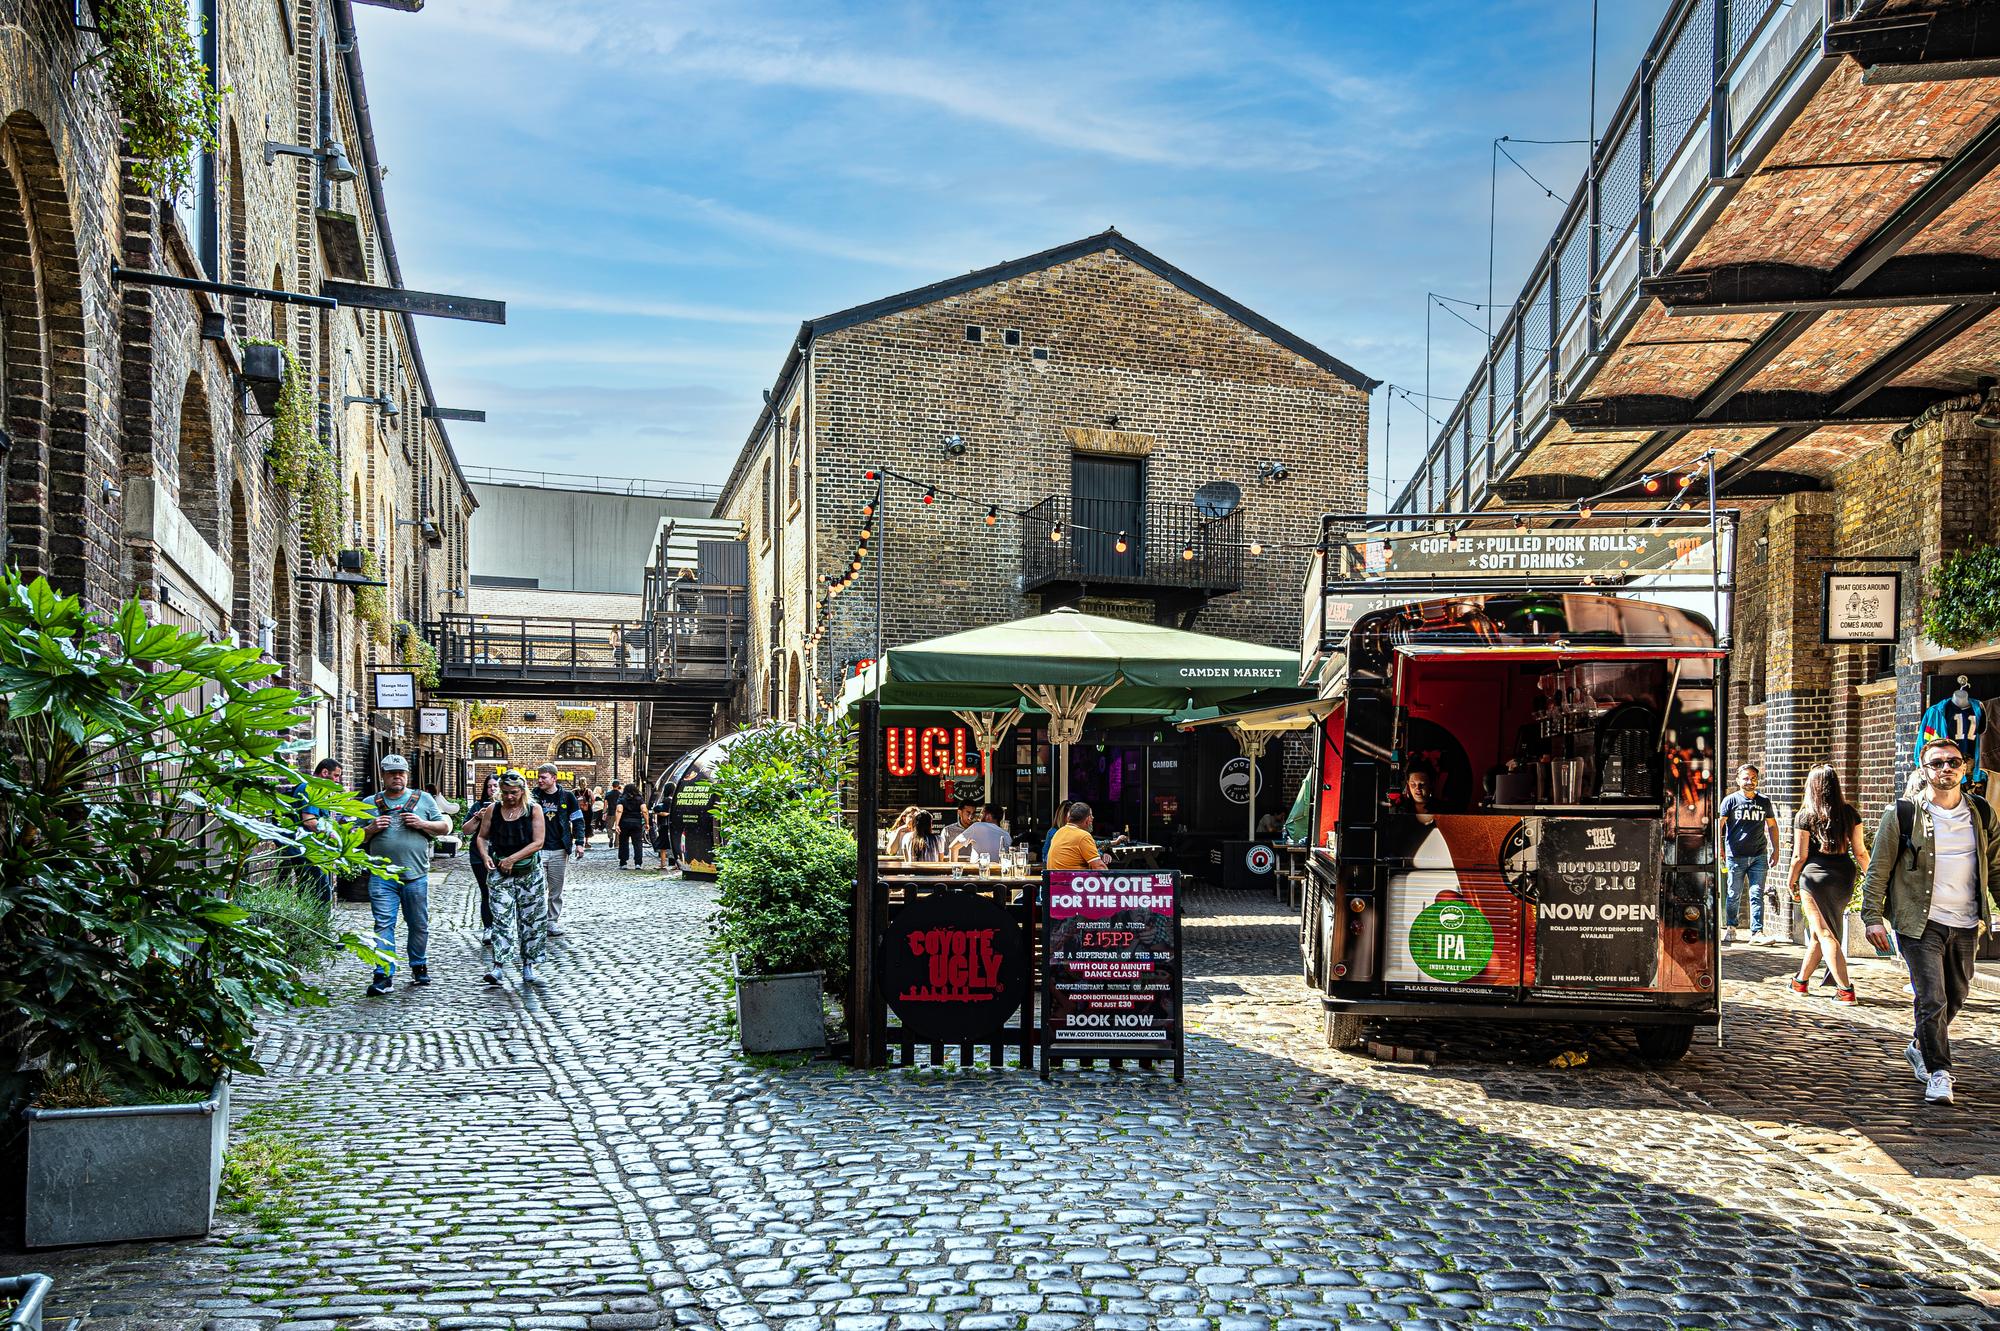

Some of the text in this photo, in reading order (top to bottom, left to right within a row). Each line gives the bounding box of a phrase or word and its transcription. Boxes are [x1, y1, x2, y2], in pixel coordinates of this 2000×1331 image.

[1486, 537, 1541, 552] PULLED
[1546, 537, 1586, 552] PORK
[1589, 536, 1638, 551] ROLLS
[1479, 553, 1575, 569] SOFT DRINKS
[1840, 621, 1883, 629] COMES AROUND
[1180, 668, 1282, 678] CAMDEN MARKET
[1152, 760, 1178, 768] CAMDEN
[1228, 762, 1250, 771] GOOS
[1227, 789, 1250, 800] ISLAN
[1734, 809, 1766, 821] GANT
[1593, 834, 1616, 845] UGLY
[1071, 876, 1152, 893] COYOTE
[1594, 876, 1636, 890] P.I.G
[1051, 895, 1173, 908] FOR THE NIGHT
[1540, 903, 1656, 920] NOW OPEN
[906, 929, 995, 956] COYOTE
[1083, 932, 1134, 948] £15PP
[1437, 934, 1466, 960] IPA
[1135, 951, 1150, 959] THE
[929, 953, 1003, 987] UGLY
[1066, 1014, 1154, 1026] BOOK NOW
